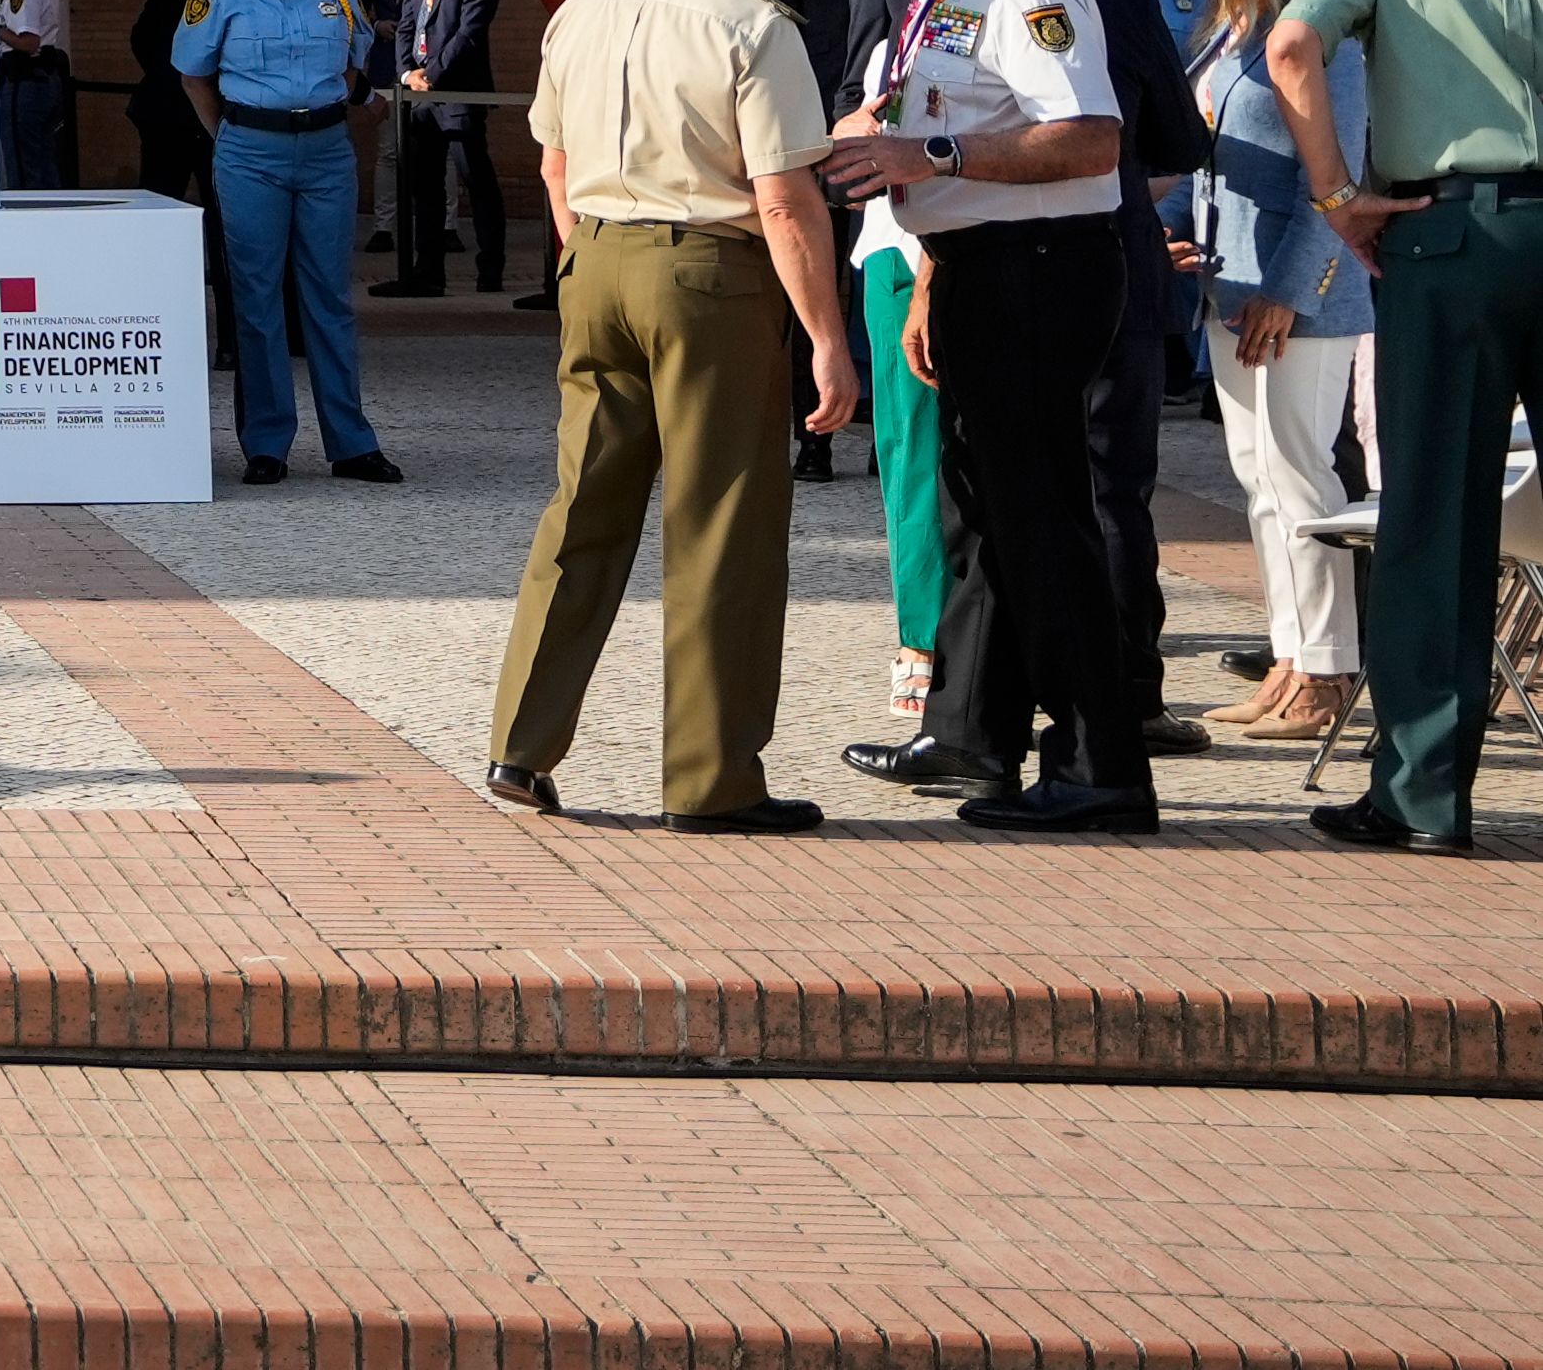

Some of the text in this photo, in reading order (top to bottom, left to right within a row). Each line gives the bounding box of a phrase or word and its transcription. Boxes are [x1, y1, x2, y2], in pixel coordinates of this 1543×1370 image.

[23, 317, 96, 325] INTERNATIONAL
[99, 316, 160, 324] CONFERENCE
[4, 331, 161, 350] FINANCING FOR
[5, 356, 161, 376] DEVELOPMENT
[6, 382, 163, 393] SEVILLA 2025
